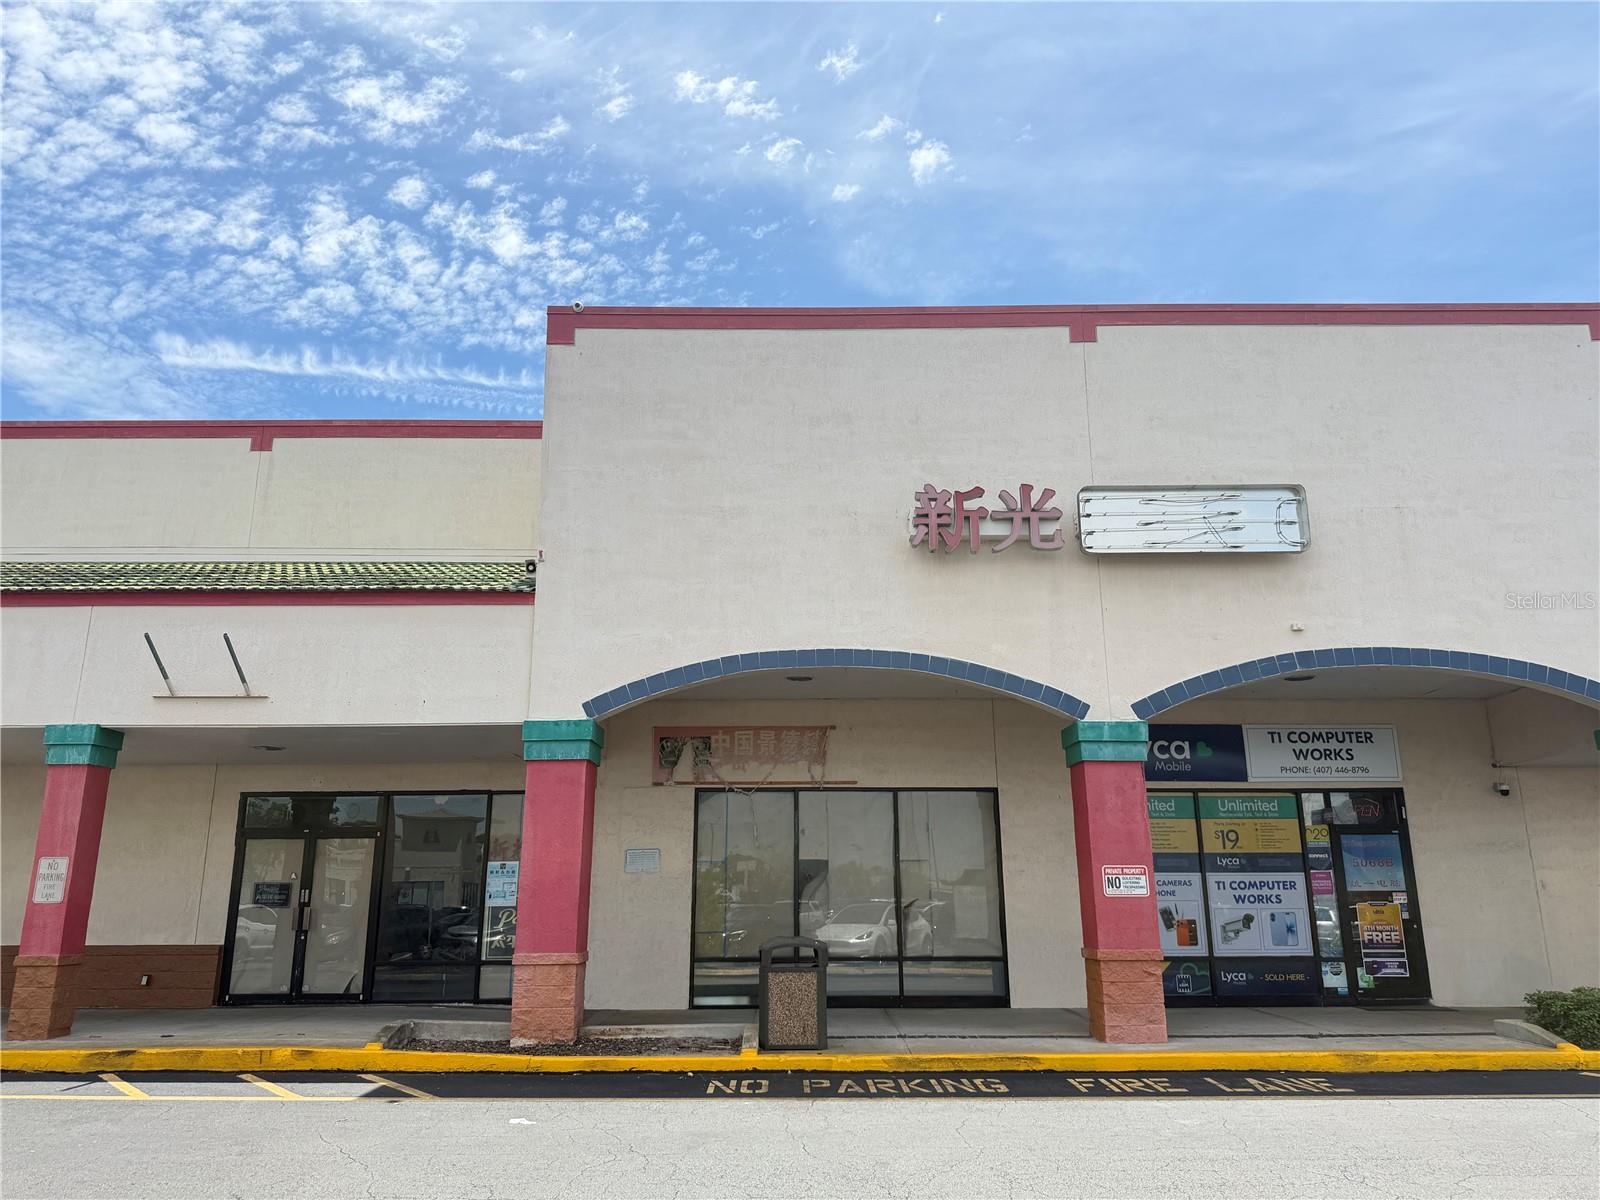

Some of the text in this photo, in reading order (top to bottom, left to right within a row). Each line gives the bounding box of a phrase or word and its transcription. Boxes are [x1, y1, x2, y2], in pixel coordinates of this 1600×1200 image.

[909, 484, 1064, 553] 新光
[1286, 731, 1374, 744] COMPUTER
[1293, 748, 1355, 761] WORKS
[1154, 761, 1192, 772] Mobile
[1280, 766, 1370, 776] PHONE: (407) 446-8796
[1218, 799, 1278, 812] Unlimited
[1214, 829, 1240, 850] $19
[48, 862, 58, 870] NO
[1216, 856, 1240, 867] Lyca
[38, 872, 64, 882] PARKING
[1106, 876, 1121, 889] NO
[1229, 880, 1297, 890] COMPUTER
[1233, 894, 1282, 904] WORKS
[1364, 932, 1400, 944] FREE
[1220, 970, 1246, 982] Lyca
[706, 1077, 1355, 1094] NO PARKING FIRE LANE
